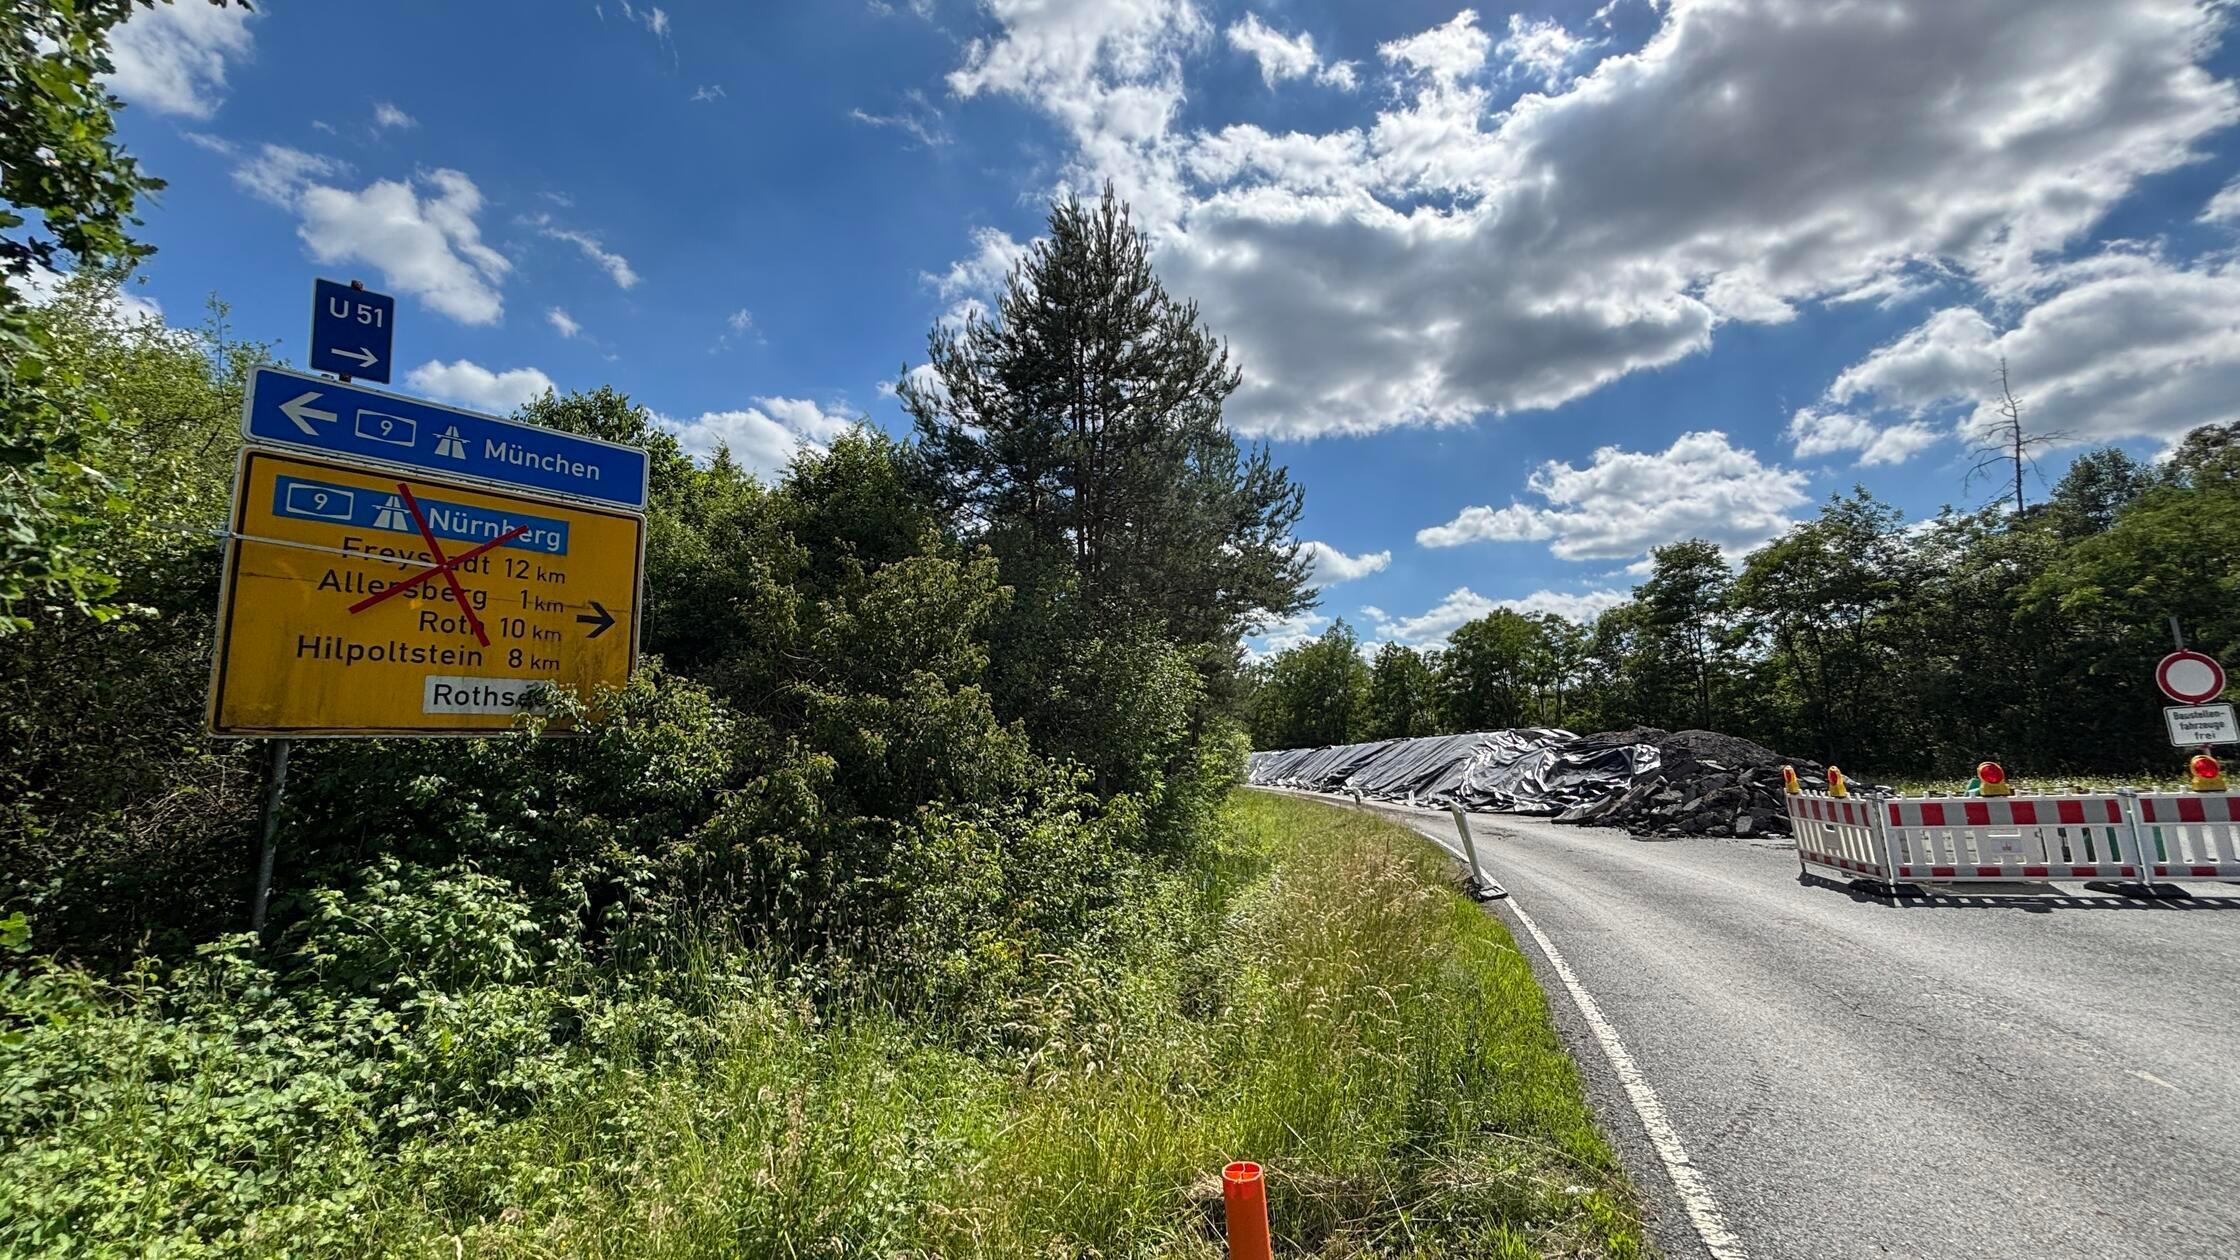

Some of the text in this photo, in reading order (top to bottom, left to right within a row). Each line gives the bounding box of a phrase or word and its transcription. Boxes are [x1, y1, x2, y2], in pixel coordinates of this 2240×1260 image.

[328, 296, 384, 328] U 51
[380, 419, 394, 437] 9
[484, 437, 600, 481] München
[313, 492, 329, 511] 9
[342, 536, 566, 584] Freysadt 12 km
[519, 589, 529, 609] 1
[534, 596, 564, 613] km
[500, 617, 526, 639] 10
[532, 625, 562, 642] km
[296, 634, 560, 671] Hilpoltstein 8 km
[2179, 721, 2225, 730] fahrzeuge
[2194, 730, 2216, 740] frei
